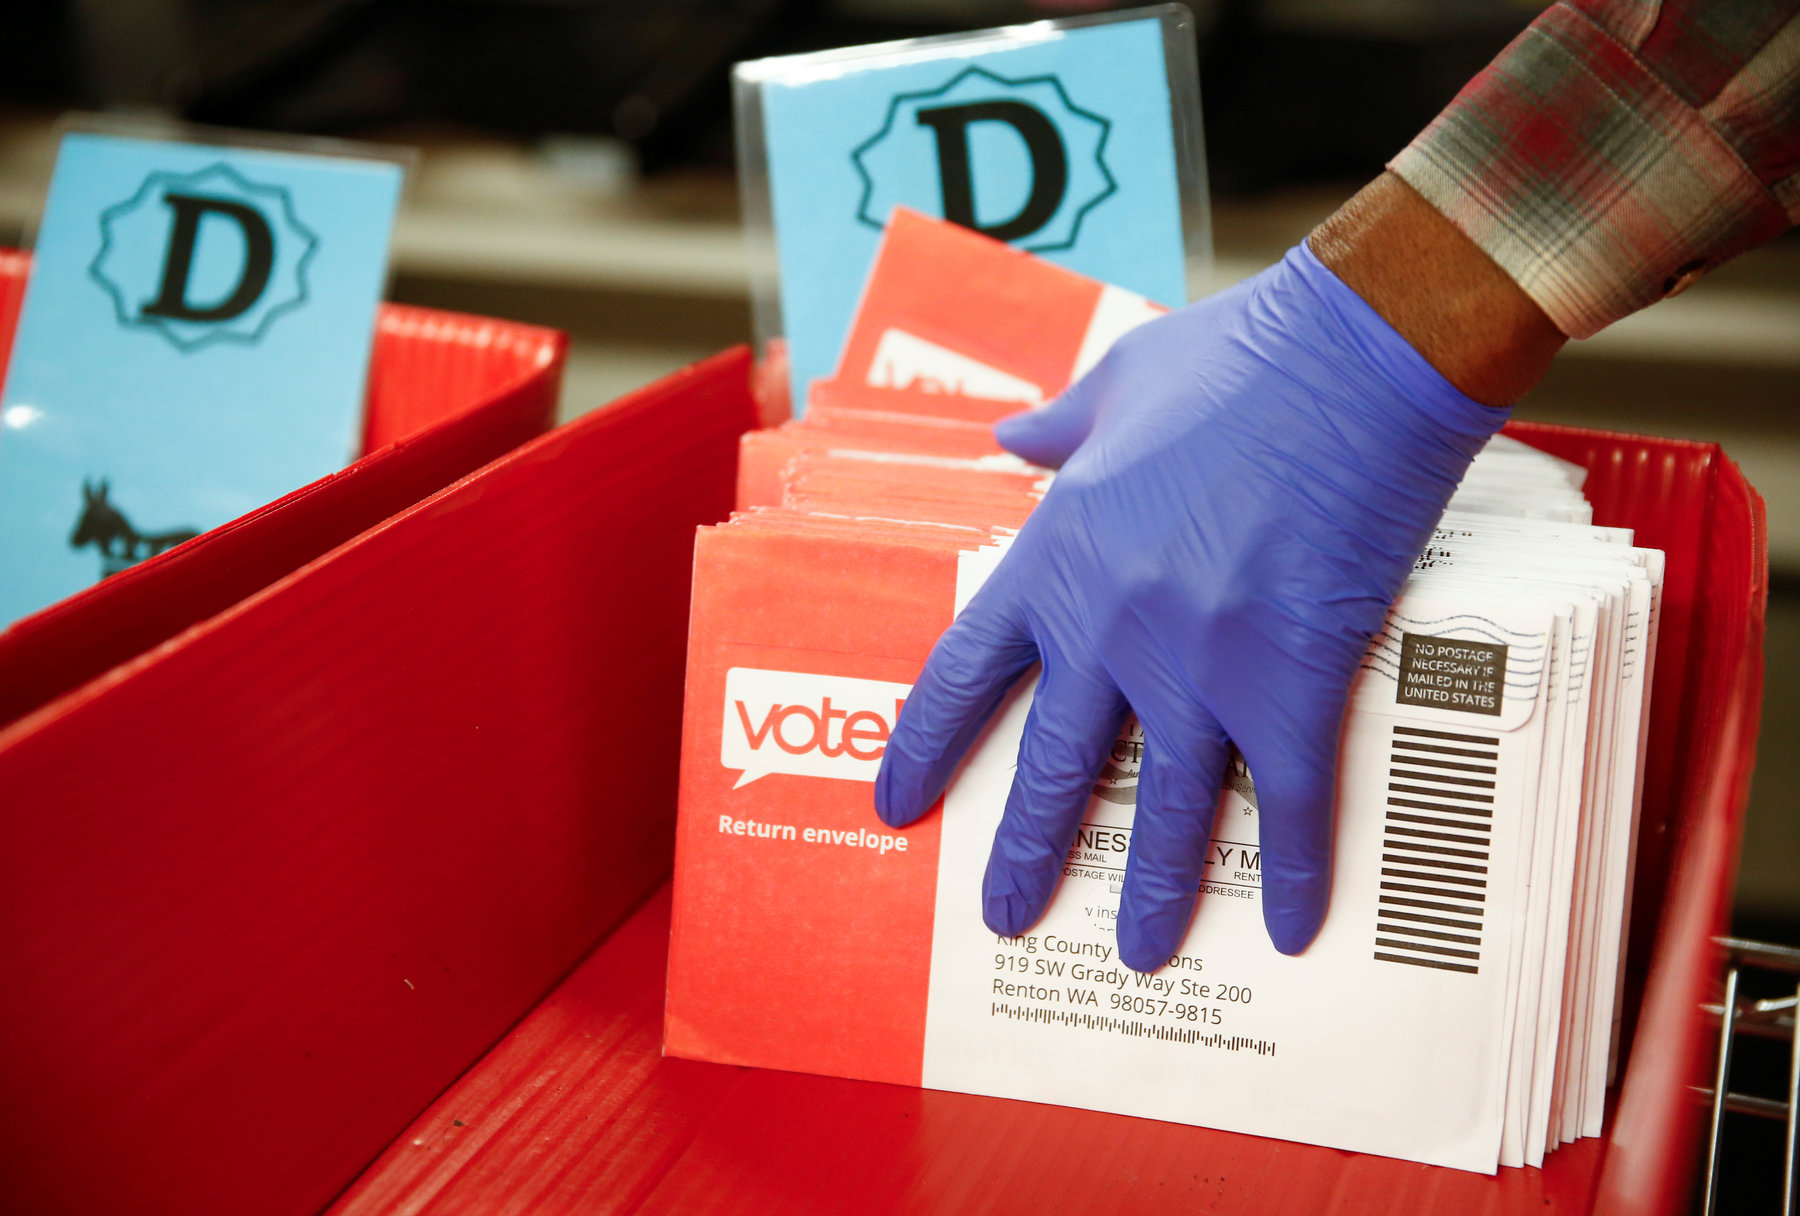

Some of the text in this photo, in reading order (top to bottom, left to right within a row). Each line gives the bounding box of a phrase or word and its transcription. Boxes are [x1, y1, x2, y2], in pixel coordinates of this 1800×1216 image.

[141, 192, 275, 322] D
[1415, 643, 1494, 662] NO POSTAGE
[1412, 658, 1494, 677] NECESSARY IF
[1407, 673, 1495, 693] MAILED IN THE
[1404, 687, 1495, 708] UNITED STATES
[734, 696, 906, 761] vote
[719, 815, 908, 855] Return envelope
[1076, 829, 1127, 853] NES
[1084, 852, 1107, 863] MAIL
[1063, 868, 1124, 883] OSTAGE WIL
[1234, 871, 1262, 883] RENT
[1198, 884, 1254, 900] DDRESSEE
[1044, 935, 1112, 963] County
[995, 954, 1252, 1004] 919 SW Grady Way Ste 200
[993, 979, 1222, 1025] Renton WA 98057-9815
